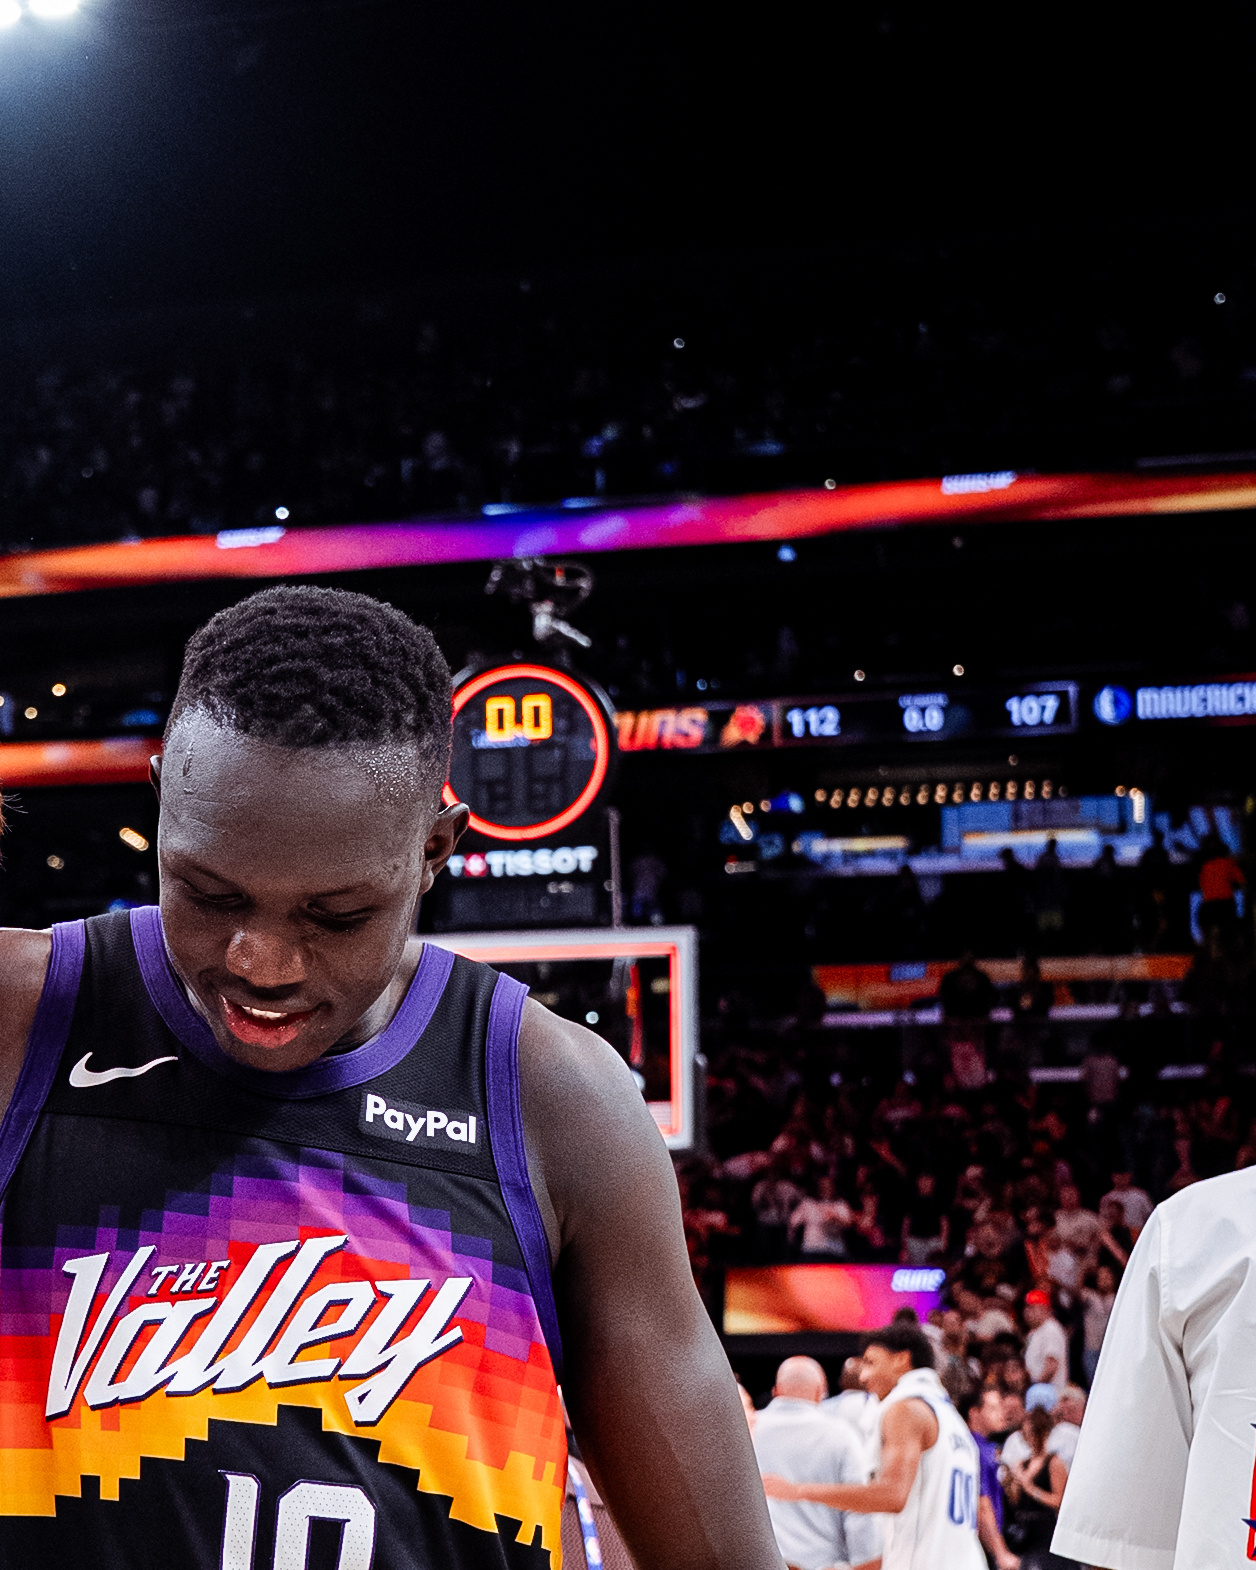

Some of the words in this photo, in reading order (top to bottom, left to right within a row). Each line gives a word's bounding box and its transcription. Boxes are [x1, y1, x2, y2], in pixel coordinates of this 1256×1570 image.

[485, 693, 552, 742] 0.0
[786, 705, 841, 738] 112
[1006, 694, 1060, 726] 107
[485, 846, 598, 877] TISSOT
[365, 1094, 476, 1144] PayPal
[146, 1259, 230, 1296] THE
[46, 1234, 473, 1426] Valley
